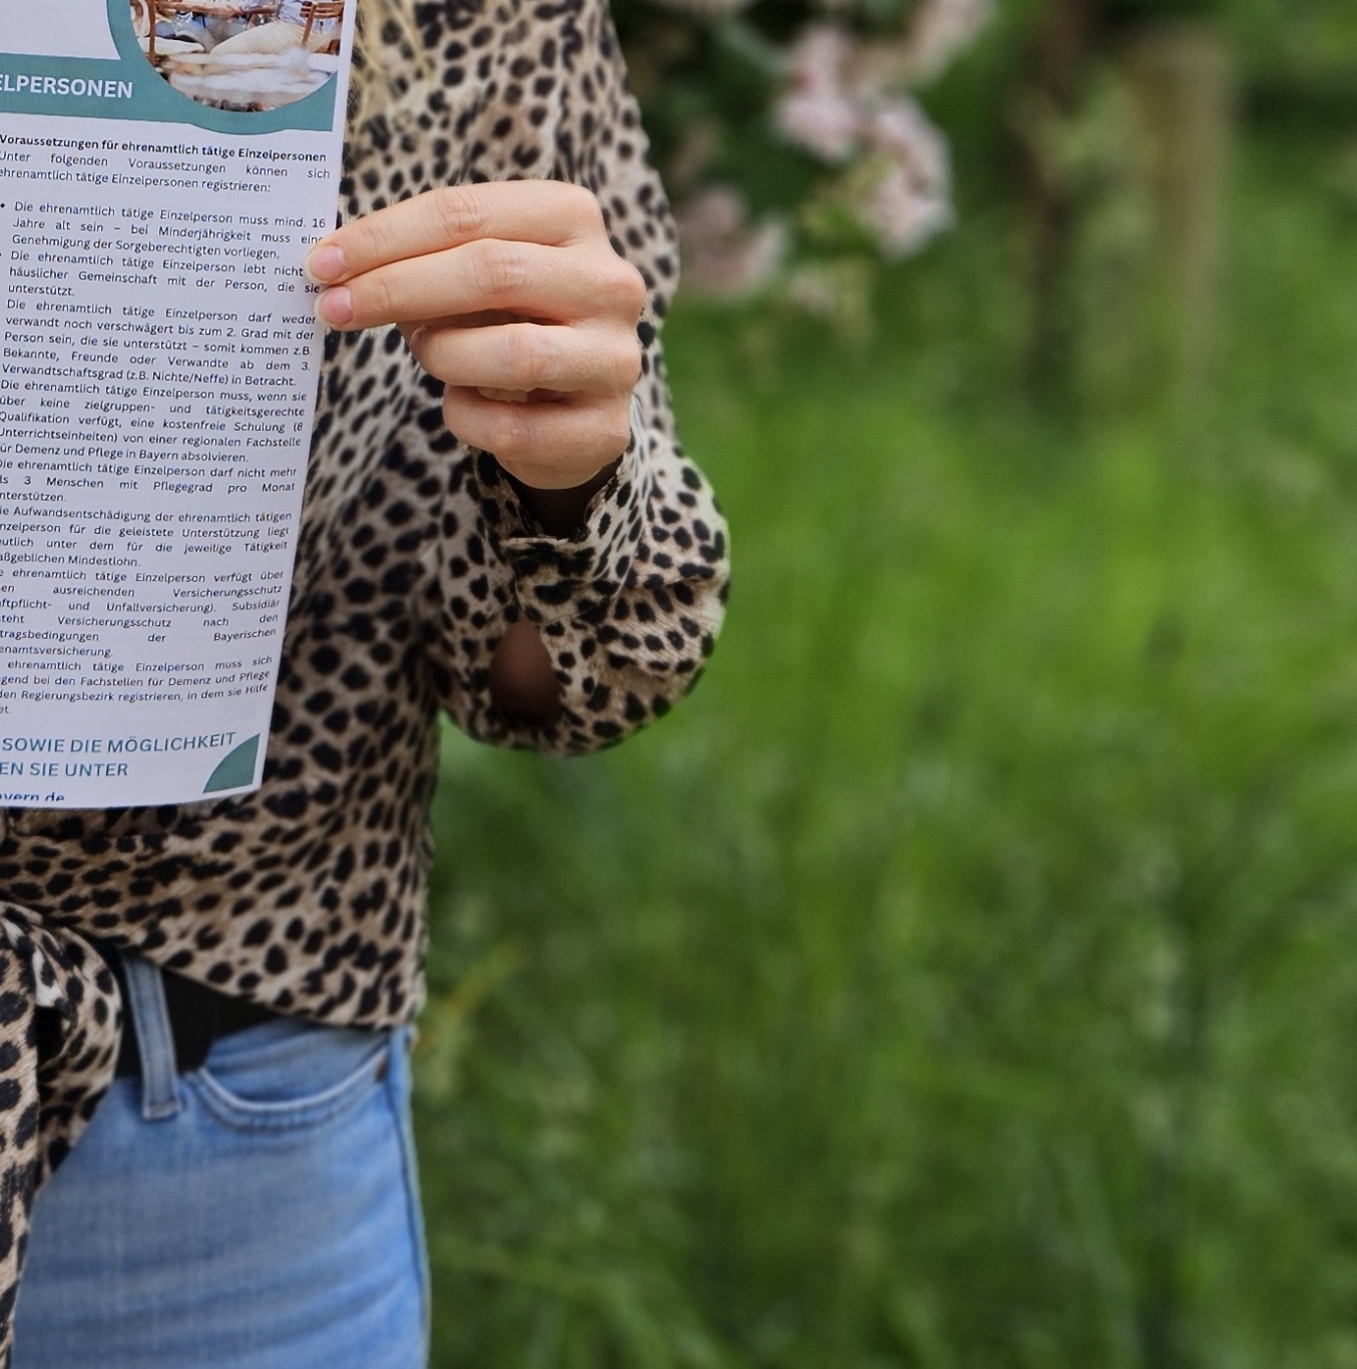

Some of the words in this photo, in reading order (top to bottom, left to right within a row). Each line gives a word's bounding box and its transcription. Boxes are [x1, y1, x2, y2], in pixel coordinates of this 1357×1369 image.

[0, 134, 98, 150] Voraussetzungen
[101, 139, 118, 149] für
[121, 141, 198, 154] ehrenamtlich
[202, 146, 235, 159] tätige
[238, 148, 325, 161] Einzelpersonen
[50, 153, 107, 167] folgenden
[128, 158, 225, 174] Voraussetzungen
[246, 164, 287, 176] können
[307, 168, 329, 178] sich
[76, 172, 108, 185] tätige
[111, 173, 198, 187] Einzelpersonen
[201, 179, 270, 192] registrieren:
[14, 201, 33, 211] Die
[39, 202, 114, 216] ehrenamtlich
[121, 208, 153, 220] tätige
[160, 209, 232, 223] Einzelperson
[239, 216, 268, 225] muss
[274, 216, 305, 227] mind.
[312, 218, 325, 228] 16
[12, 234, 90, 250] Genehmigung
[93, 238, 112, 248] der
[115, 240, 220, 257] Sorgeberechtigten
[223, 247, 279, 260] vorliegen.
[8, 284, 74, 295] unterstützt.
[7, 298, 25, 309] Die
[36, 300, 111, 314] ehrenamtlich
[122, 306, 154, 318] tätige
[165, 308, 237, 321] Einzelperson
[248, 312, 272, 322] darf
[281, 314, 315, 324] weder
[149, 434, 177, 444] einer
[182, 435, 240, 447] regionalen
[246, 436, 300, 446] Fachstelle
[15, 443, 60, 455] Demenz
[63, 446, 84, 456] und
[88, 447, 123, 460] Pflege
[126, 449, 136, 458] in
[139, 449, 178, 461] Bayern
[181, 451, 248, 462] absolvieren.
[13, 506, 150, 523] Aufwandsentschädigung
[154, 512, 173, 521] der
[178, 513, 250, 522] ehrenamtlich
[255, 512, 291, 523] tätigen
[68, 555, 140, 566] Mindestlohn.
[2, 737, 64, 752] SOWIE
[70, 739, 102, 752] DIE
[107, 731, 237, 754] MÖGLICHKEIT
[29, 762, 58, 776] SIE
[65, 763, 128, 776] UNTER
